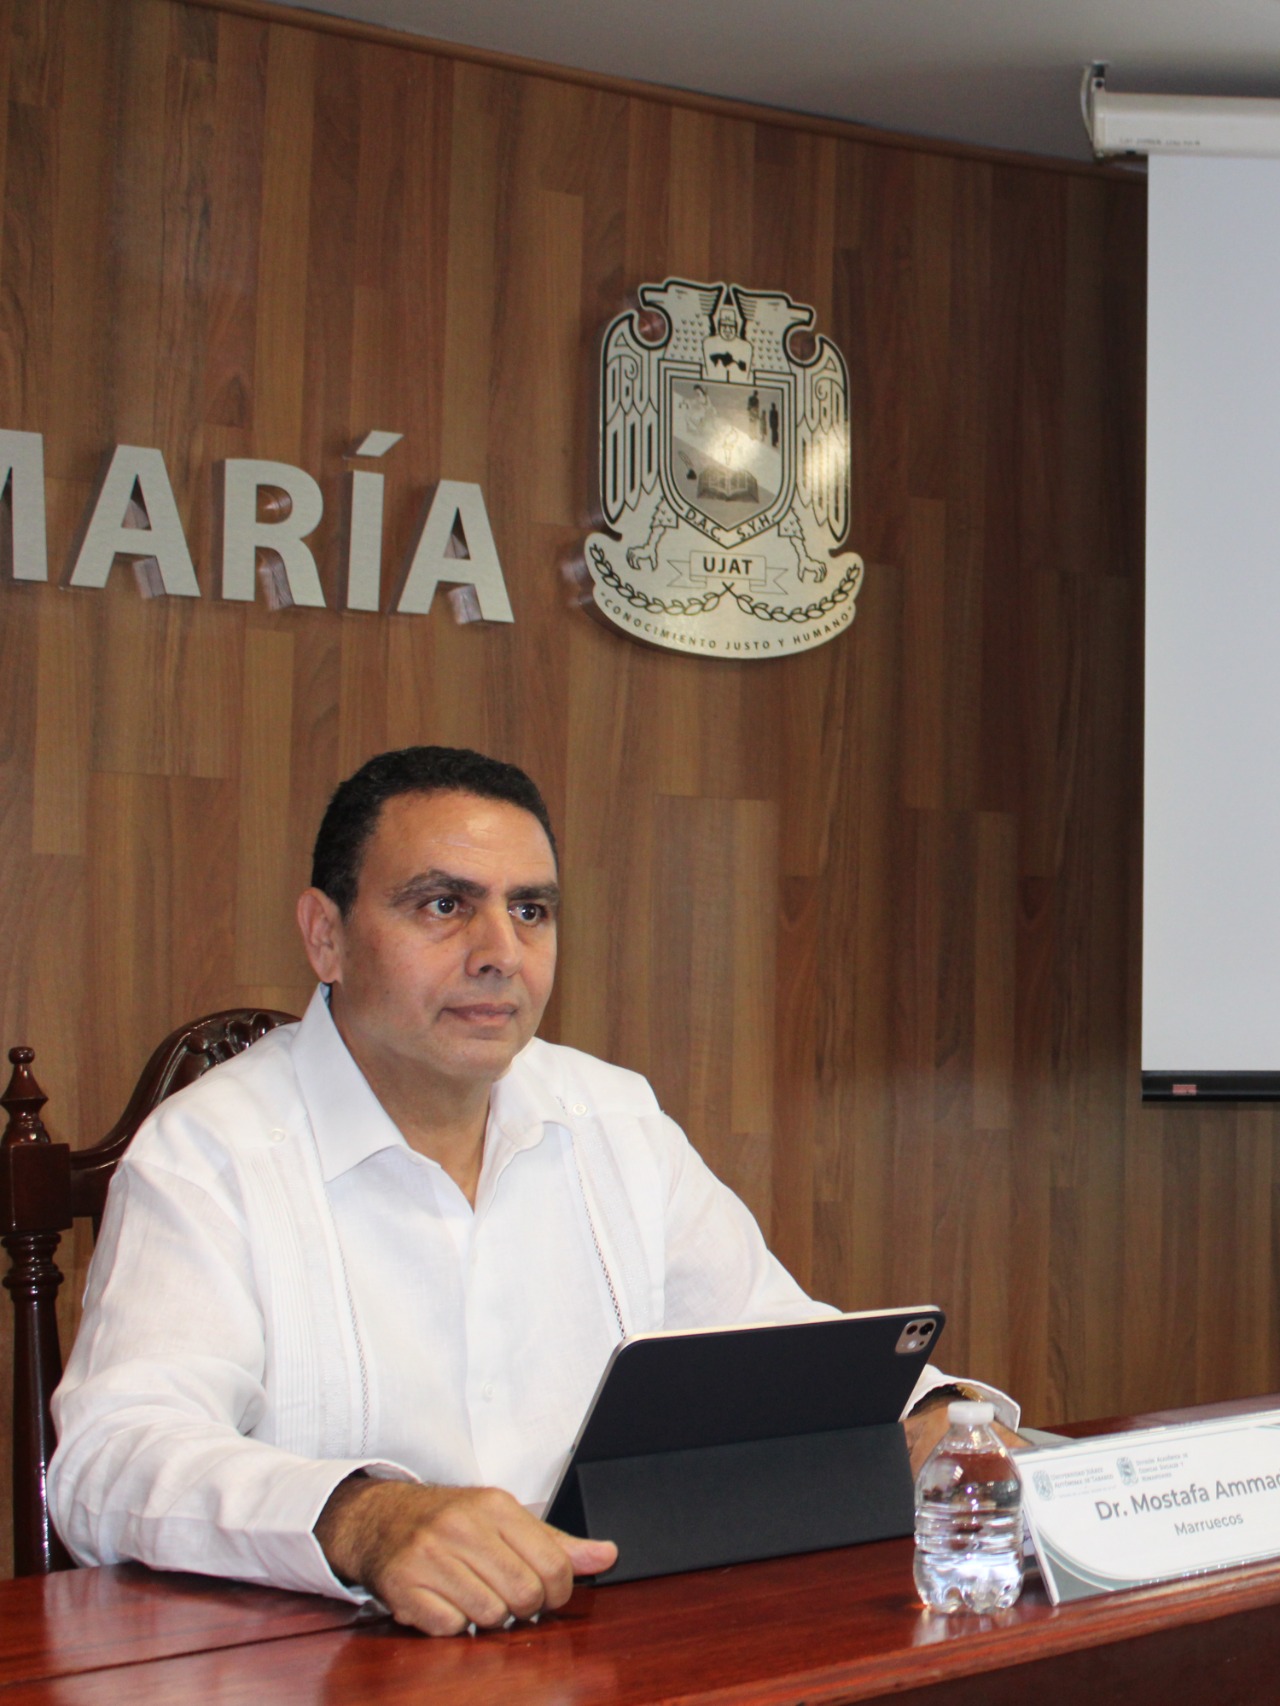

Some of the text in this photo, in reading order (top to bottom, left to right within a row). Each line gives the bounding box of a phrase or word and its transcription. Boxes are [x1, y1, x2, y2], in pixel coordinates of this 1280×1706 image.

[684, 507, 774, 542] D.A.C. S.Y.H.
[702, 556, 753, 576] UJAT
[726, 640, 771, 651] JUSTO
[778, 638, 785, 648] Y
[1095, 1499, 1128, 1521] Dr.
[1130, 1483, 1210, 1515] Mostafa
[1173, 1513, 1244, 1536] Marruecos
